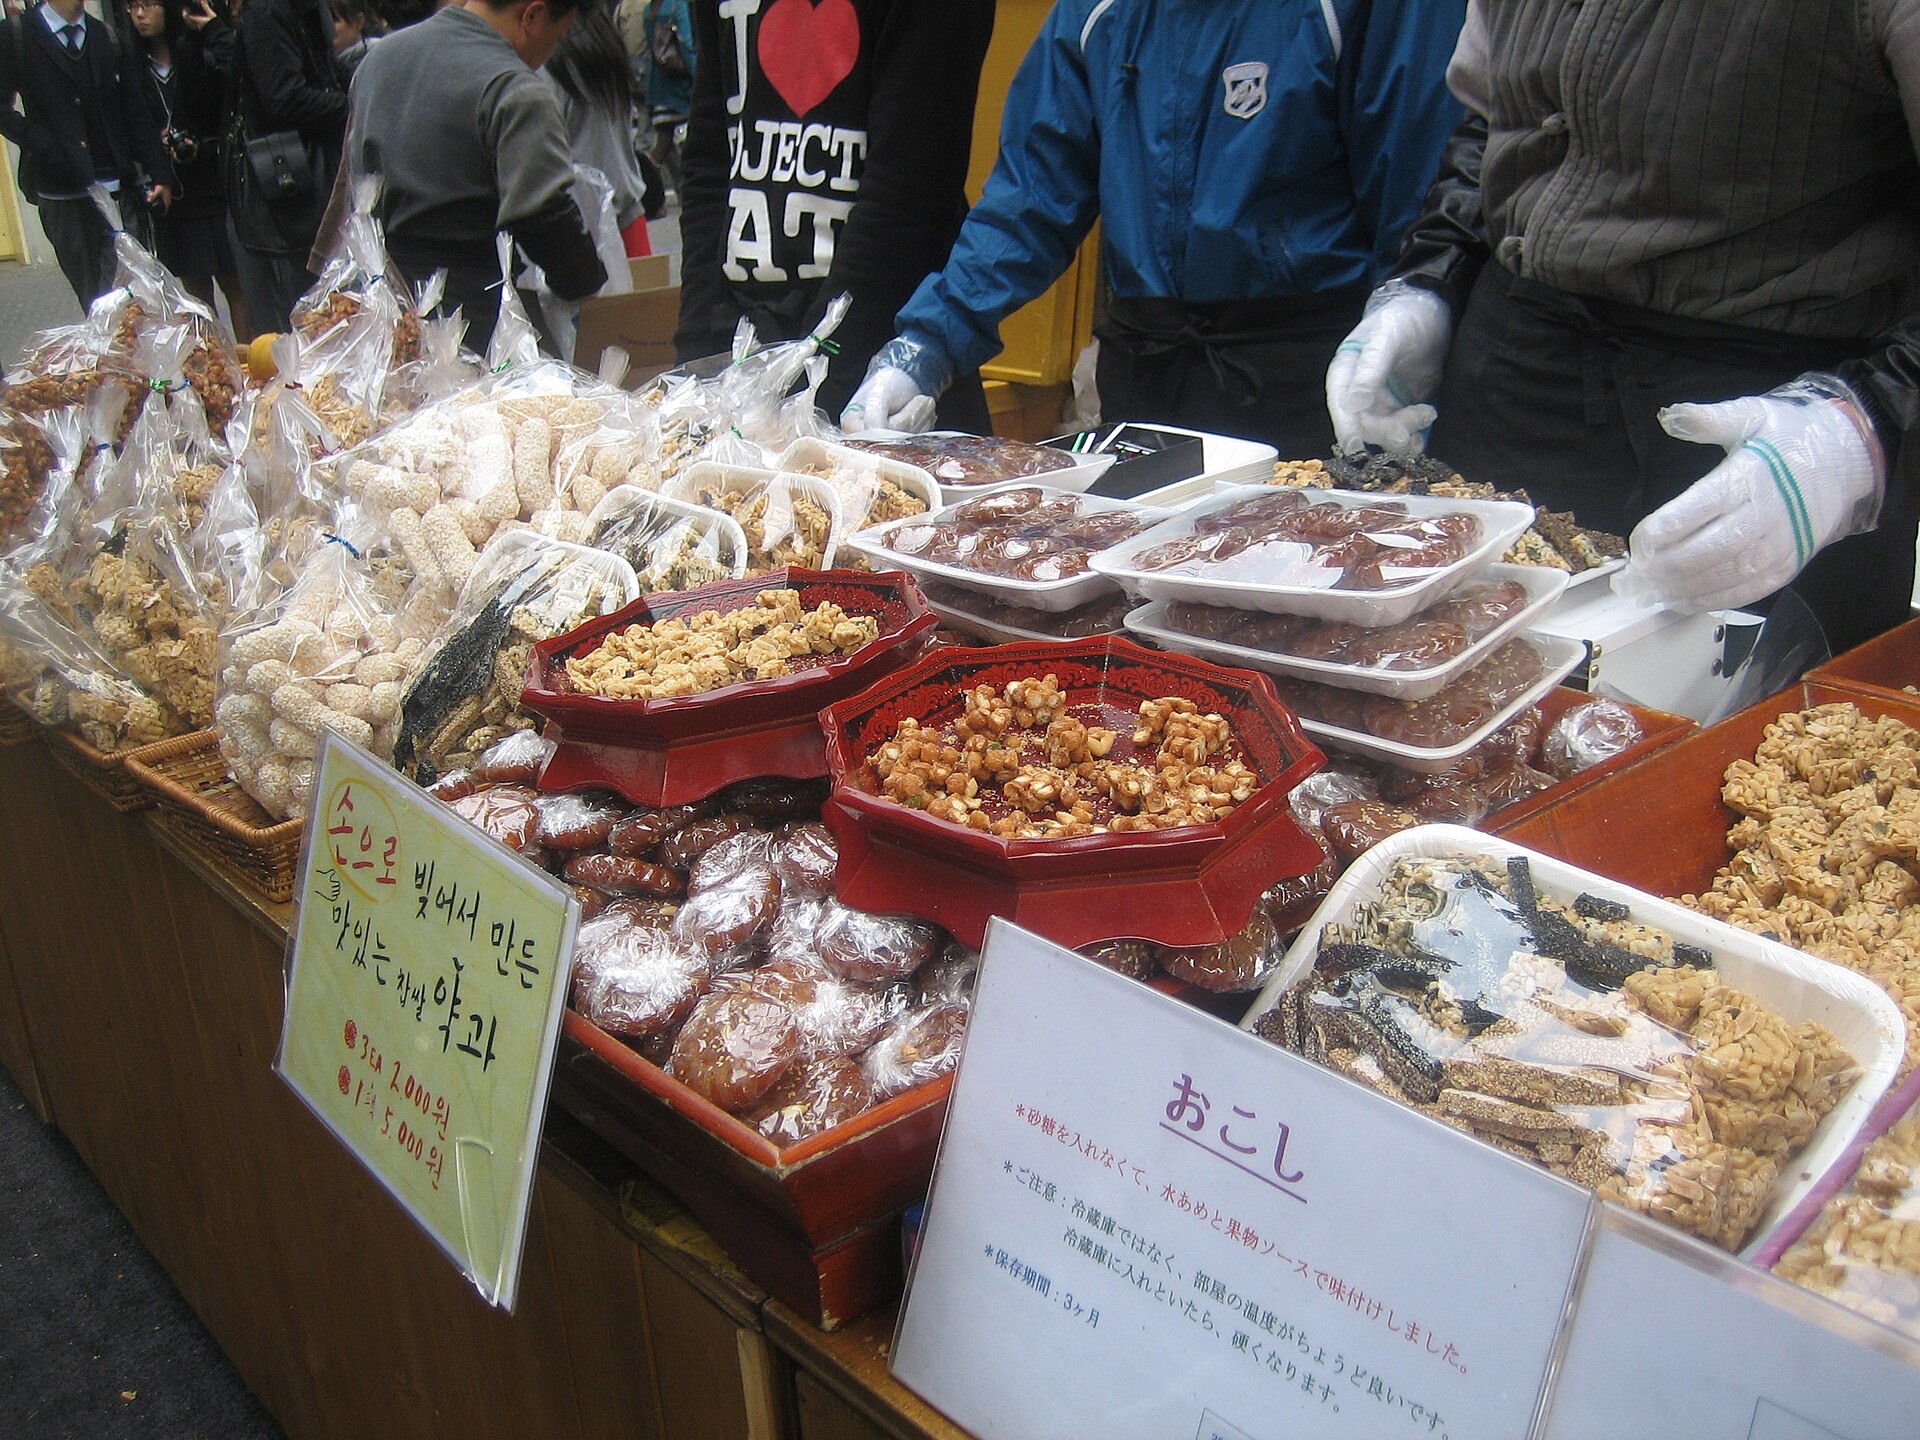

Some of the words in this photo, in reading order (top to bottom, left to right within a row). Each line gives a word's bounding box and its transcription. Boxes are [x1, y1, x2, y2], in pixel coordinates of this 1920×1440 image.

[328, 785, 398, 885] 손으로
[491, 918, 540, 989] 만든
[332, 900, 391, 986] 맛있는
[396, 968, 427, 1022] 찹쌀
[433, 956, 497, 1072] 약과
[360, 1034, 383, 1075] 3EA
[1165, 1072, 1304, 1183] おこし
